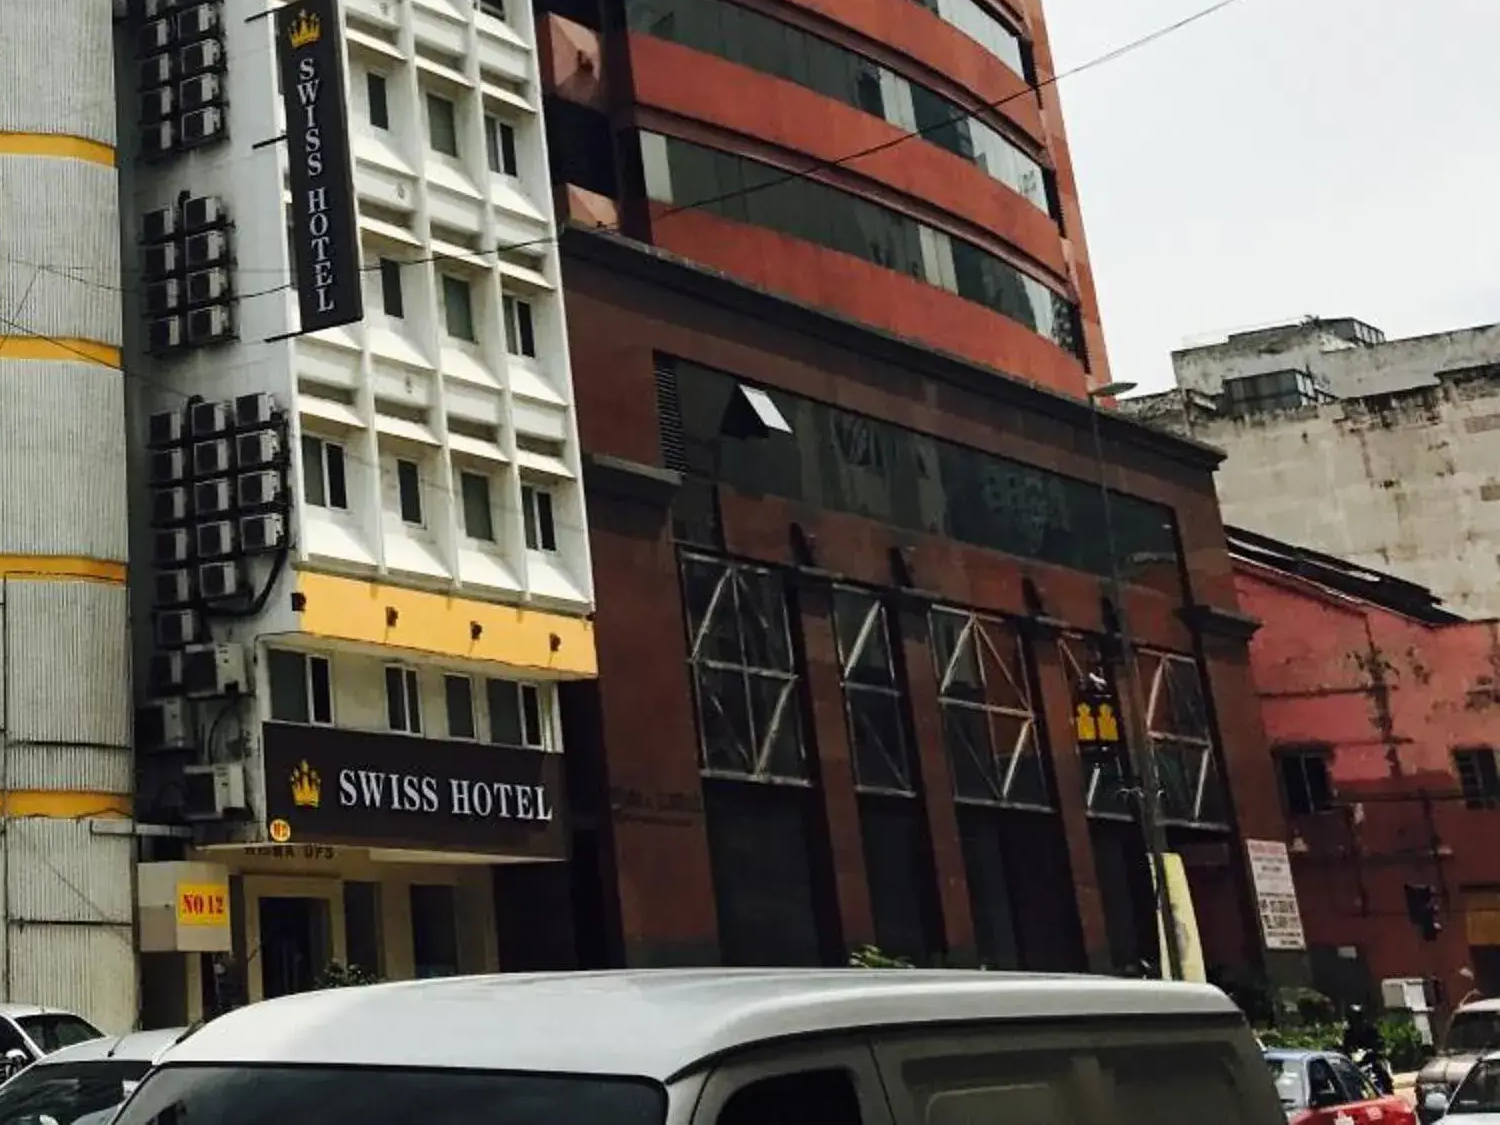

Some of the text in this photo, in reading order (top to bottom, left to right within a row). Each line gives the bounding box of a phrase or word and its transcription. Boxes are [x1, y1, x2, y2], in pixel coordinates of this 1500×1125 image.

[296, 57, 336, 312] SWISS HOTEL
[339, 769, 553, 821] SWISS HOTEL
[183, 892, 225, 915] NO 12
